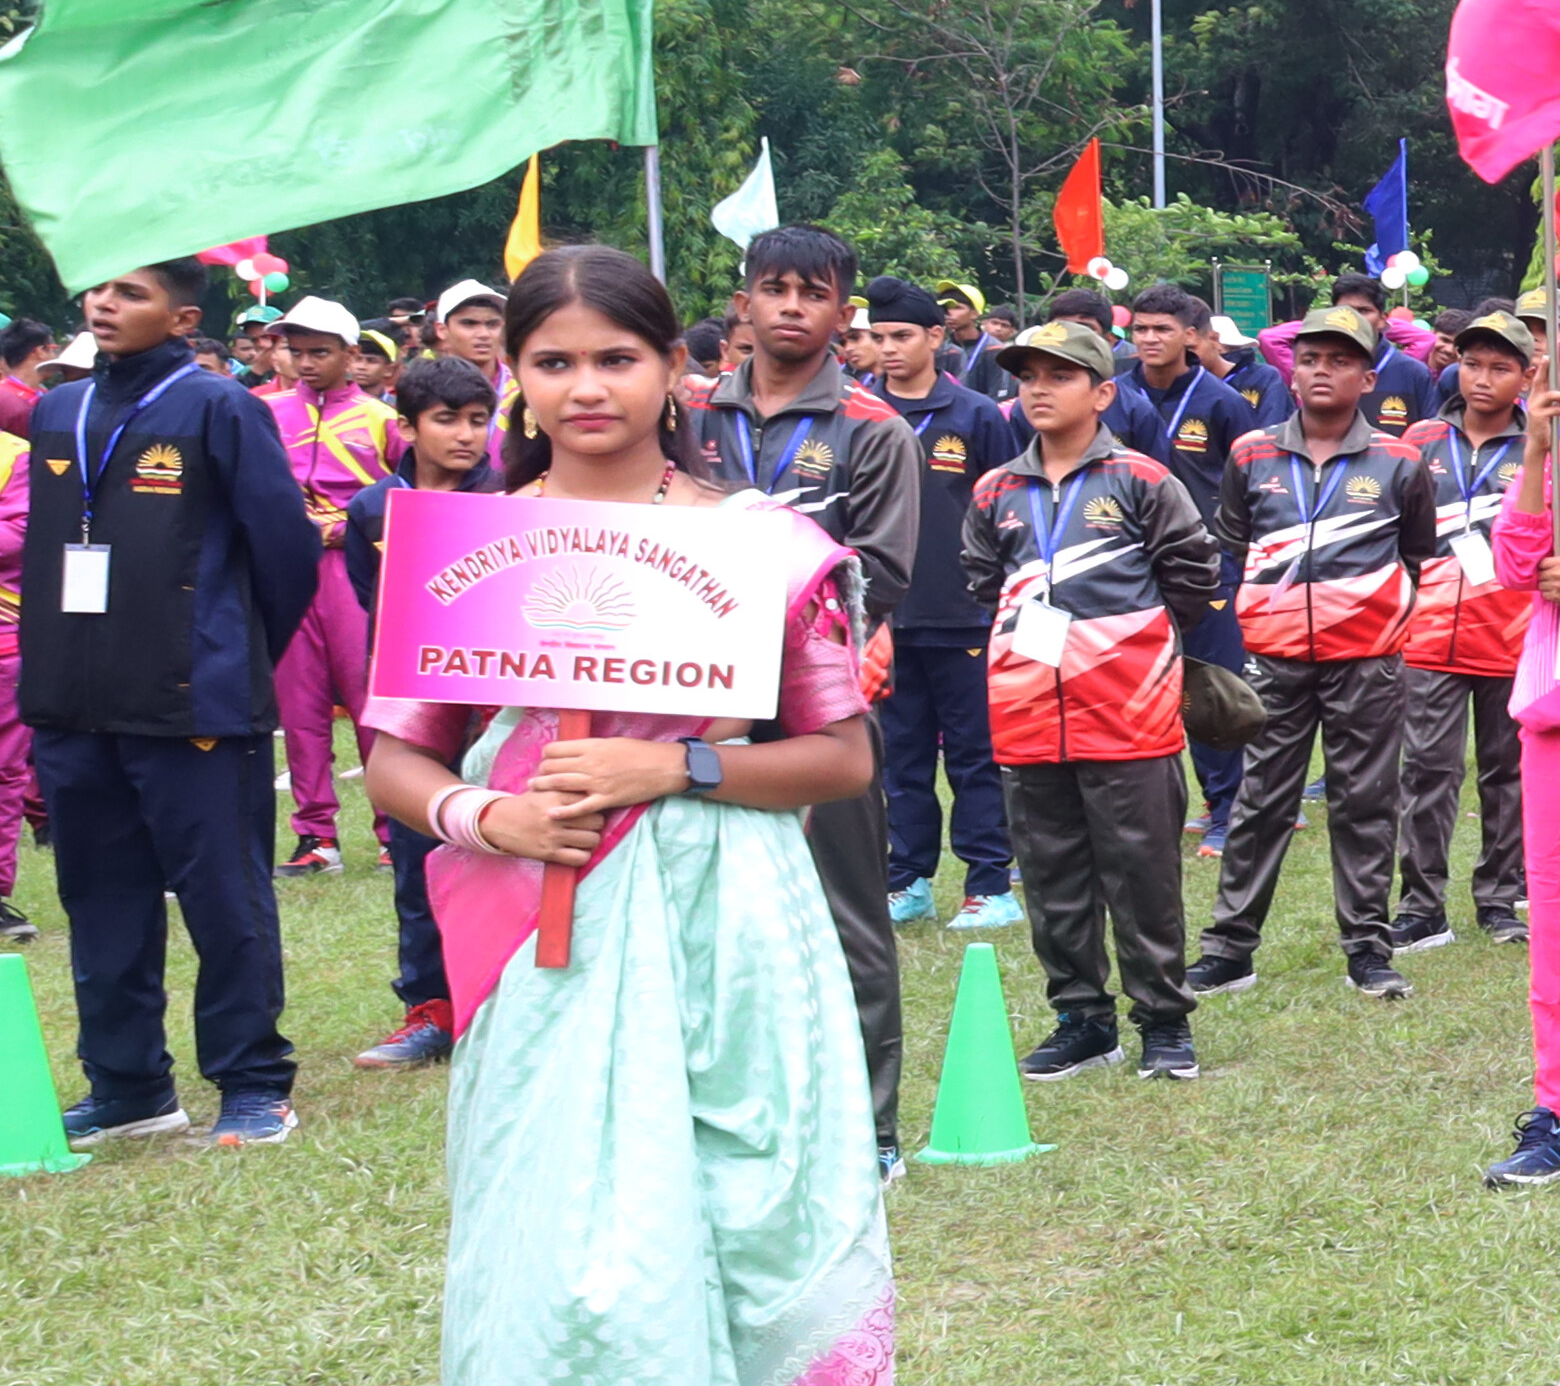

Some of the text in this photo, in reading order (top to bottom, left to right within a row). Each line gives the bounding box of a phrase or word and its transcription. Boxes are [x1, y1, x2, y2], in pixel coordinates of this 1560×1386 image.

[426, 527, 740, 619] KENDRIYA VIDYALAYA SANGATHAN
[419, 646, 736, 690] PATNA REGION
